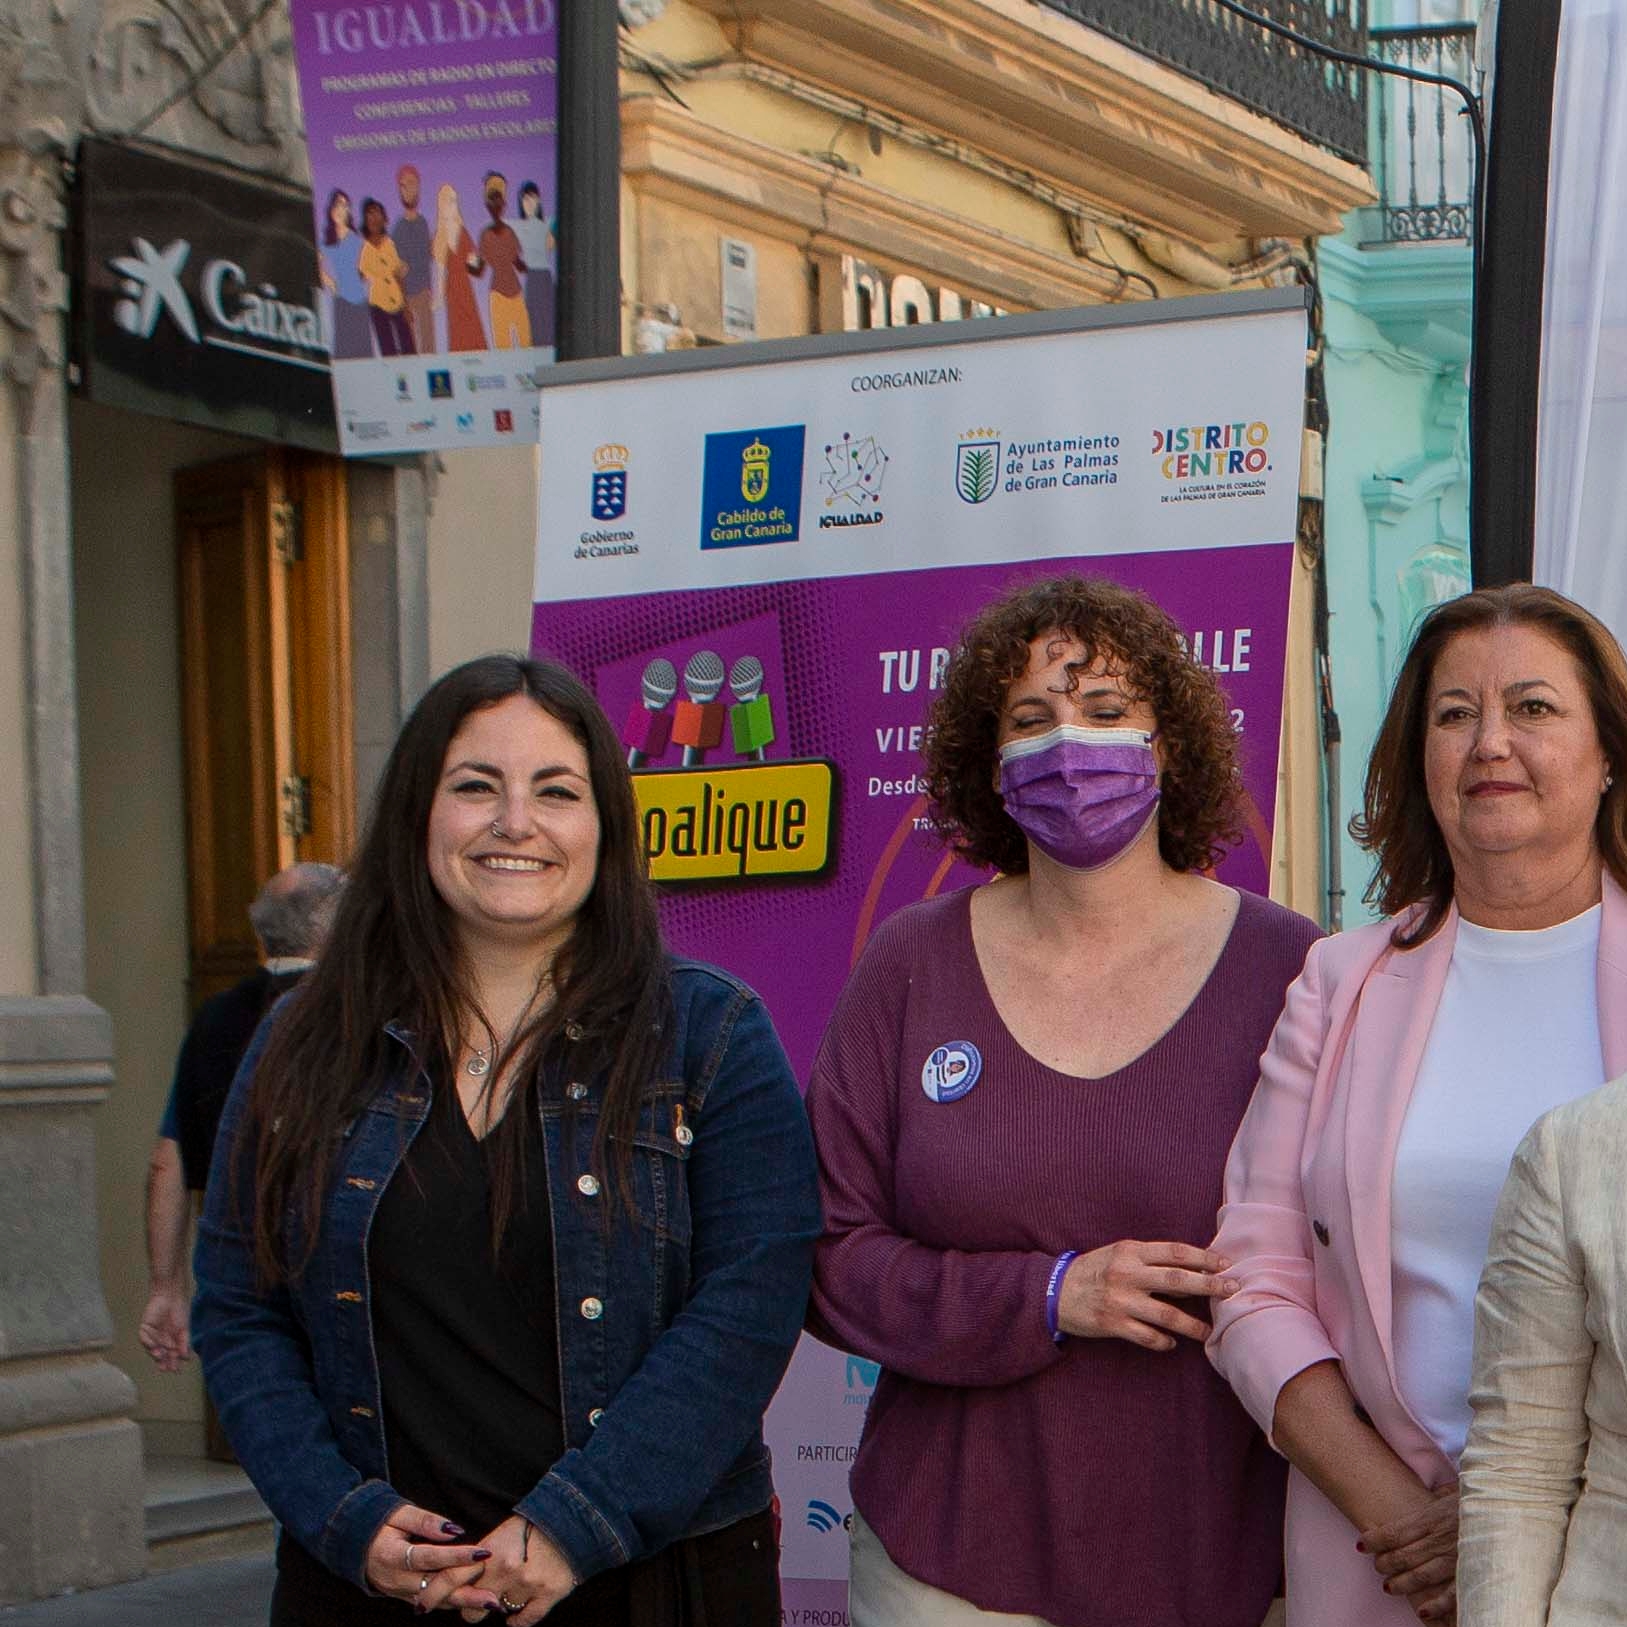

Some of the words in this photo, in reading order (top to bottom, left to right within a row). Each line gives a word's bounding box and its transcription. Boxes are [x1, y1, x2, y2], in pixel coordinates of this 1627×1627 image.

[313, 0, 558, 55] IGUALDAD
[851, 367, 963, 393] COORGANIZAN:
[1007, 434, 1120, 459] Ayuntamiento
[1151, 420, 1269, 454] DISTRITO
[1006, 458, 1024, 475] de
[1031, 455, 1055, 472] Las
[1064, 451, 1119, 470] Palmas
[1004, 476, 1022, 493] de
[1024, 474, 1058, 491] Gran
[1062, 470, 1118, 488] Canaria
[717, 508, 766, 526] Cabildo
[768, 506, 785, 521] de
[580, 529, 635, 545] Gobierno
[710, 525, 742, 542] Gran
[744, 521, 793, 538] Canaria
[574, 546, 588, 560] de
[588, 543, 640, 558] Canarias
[879, 650, 921, 694] TU
